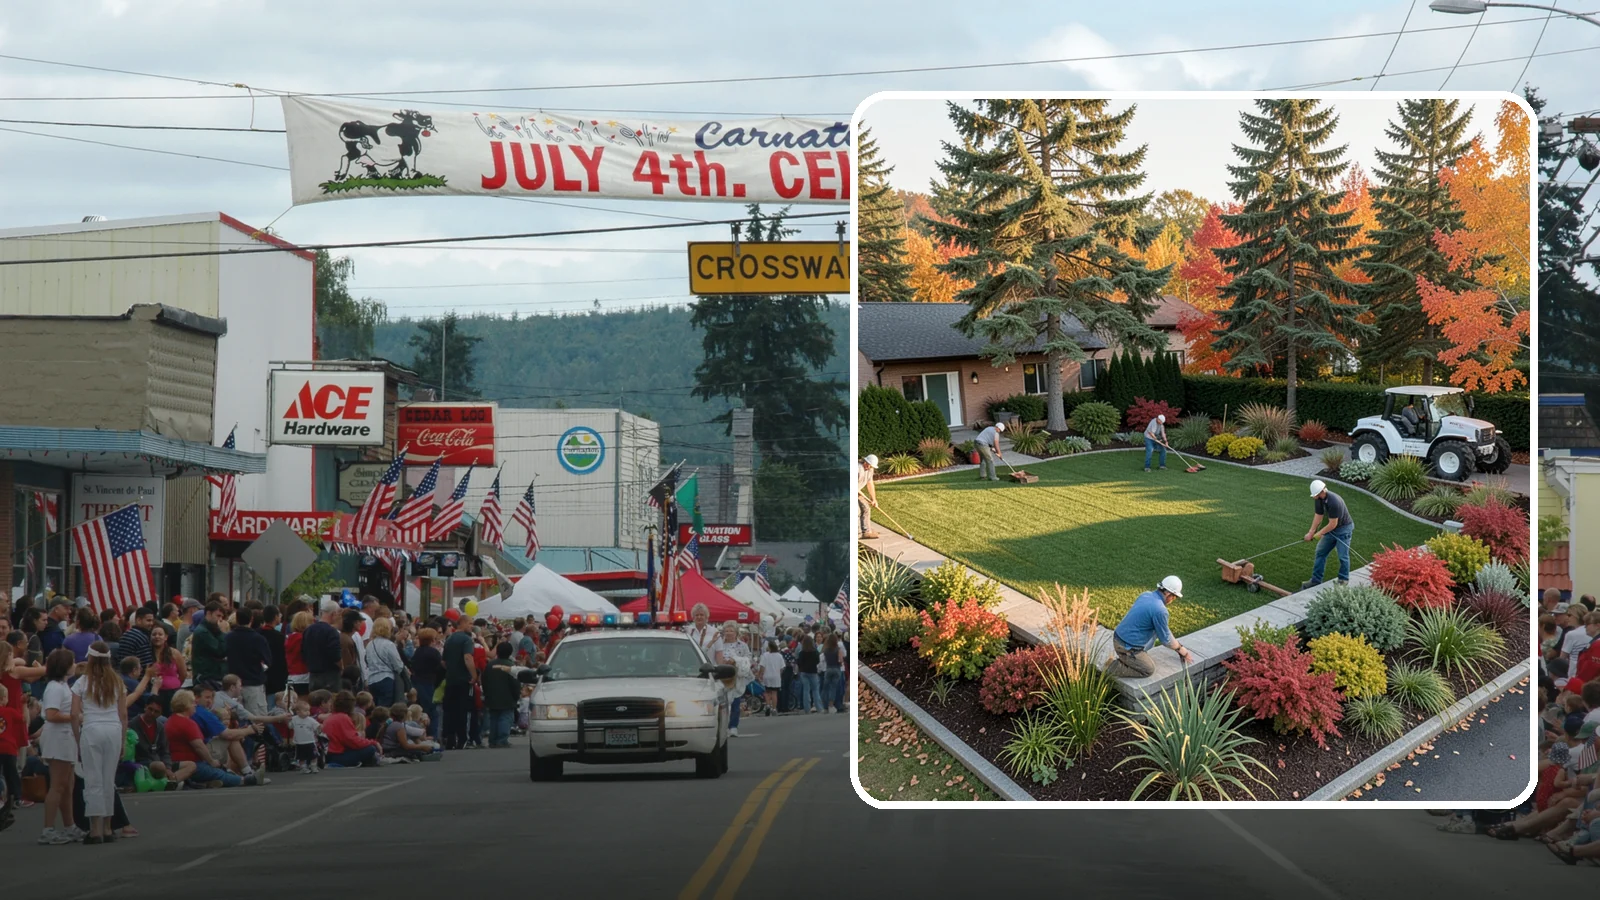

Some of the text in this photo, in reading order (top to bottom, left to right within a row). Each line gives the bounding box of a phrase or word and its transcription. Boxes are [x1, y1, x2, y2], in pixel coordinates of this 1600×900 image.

[481, 141, 605, 192] JULY
[632, 150, 747, 197] 4th.
[697, 253, 850, 280] CROSSWA
[283, 380, 373, 420] ACE
[405, 409, 452, 422] CEDAR
[283, 421, 371, 436] Hardware
[416, 428, 477, 446] Coca-Cola
[83, 485, 155, 494] St. Vincent de Paul
[212, 516, 330, 535] HARDARE
[688, 526, 741, 534] CRNATION
[699, 535, 730, 543] GLASS
